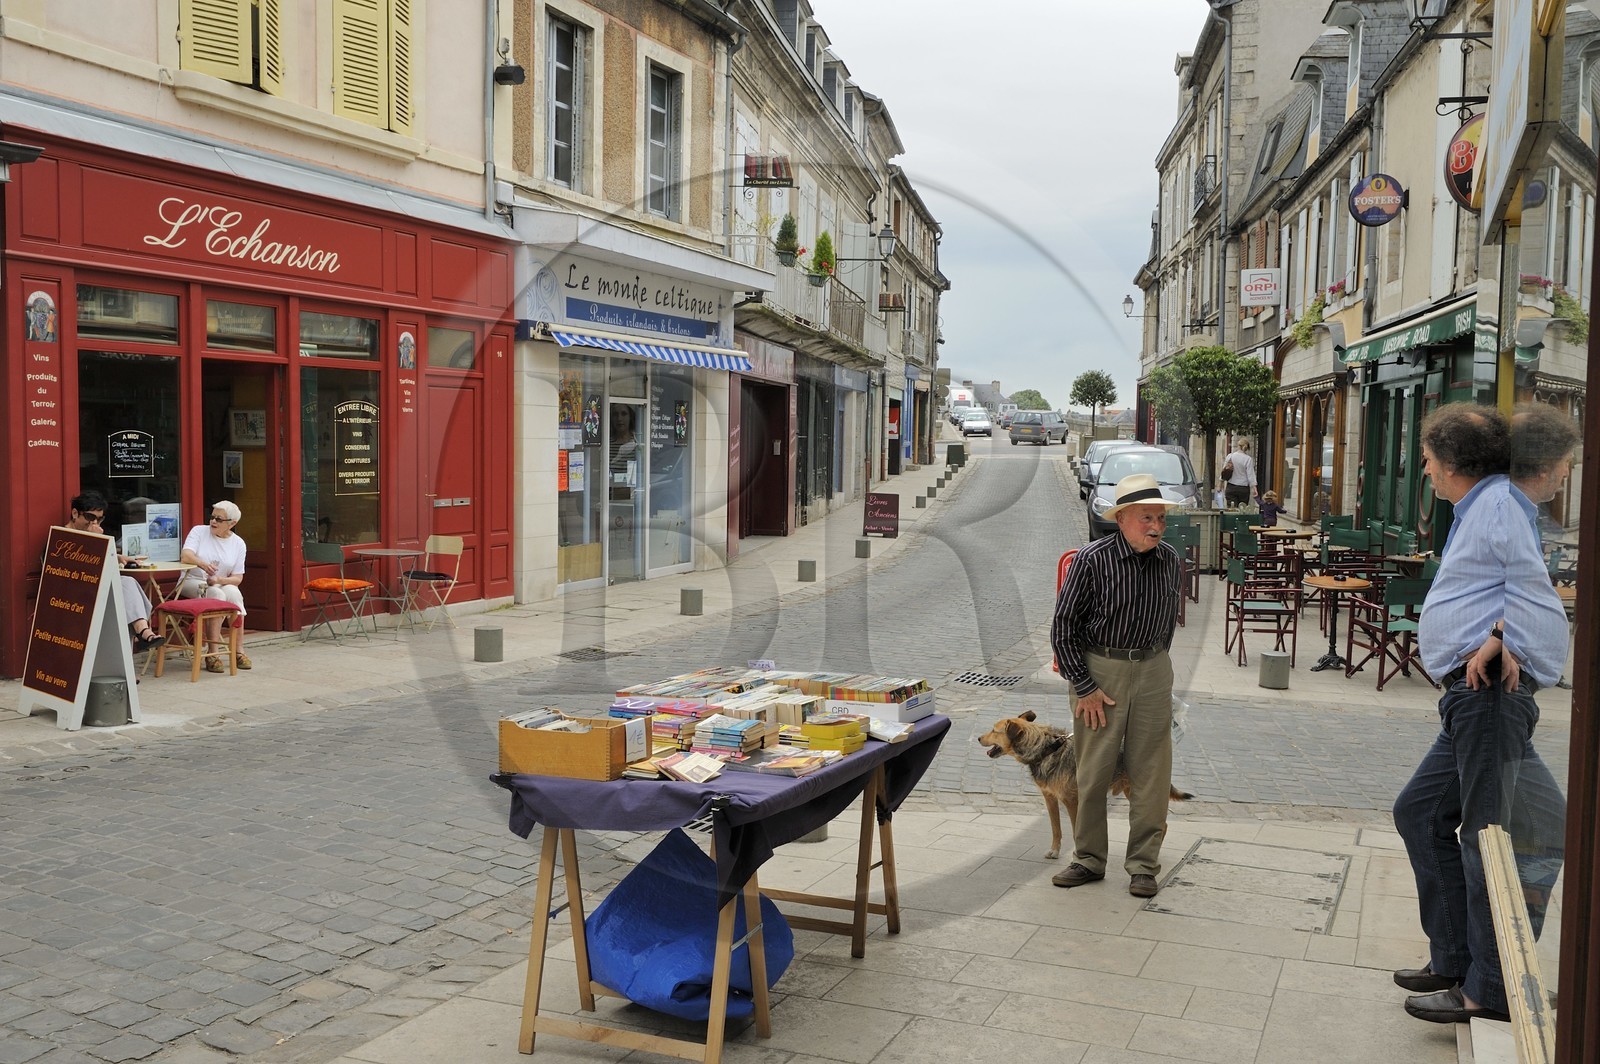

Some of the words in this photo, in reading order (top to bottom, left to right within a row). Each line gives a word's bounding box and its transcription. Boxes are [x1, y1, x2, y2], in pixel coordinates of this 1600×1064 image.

[1354, 195, 1402, 206] FOSTER'S
[143, 197, 341, 274] L'Echanson
[564, 263, 590, 290] Le
[597, 275, 648, 309] monde
[655, 285, 714, 319] celtique
[1244, 283, 1277, 292] ORPI
[589, 303, 623, 326] Produits
[626, 313, 658, 331] irlandais
[660, 319, 667, 332] &
[667, 320, 691, 336] bretons
[1411, 324, 1429, 346] ROAD
[1455, 309, 1472, 334] IRISH
[33, 354, 50, 362] Vins
[26, 373, 58, 383] Produits
[31, 400, 55, 408] Terroir
[337, 403, 360, 415] ENTREE
[360, 404, 378, 416] LIBRE
[30, 418, 57, 427] Galerie
[27, 439, 60, 448] Cadeaux
[866, 495, 888, 506] Livres
[868, 508, 897, 519] Anciens
[50, 538, 102, 566] L'Echanson
[45, 564, 71, 579] Produits
[71, 570, 79, 580] du
[80, 571, 99, 584] Terroir
[49, 596, 70, 611] Galerie
[70, 601, 85, 614] d'art
[34, 628, 51, 642] Petite
[51, 634, 84, 651] restauration
[35, 669, 45, 681] Vin
[45, 672, 54, 683] au
[53, 676, 68, 689] verre
